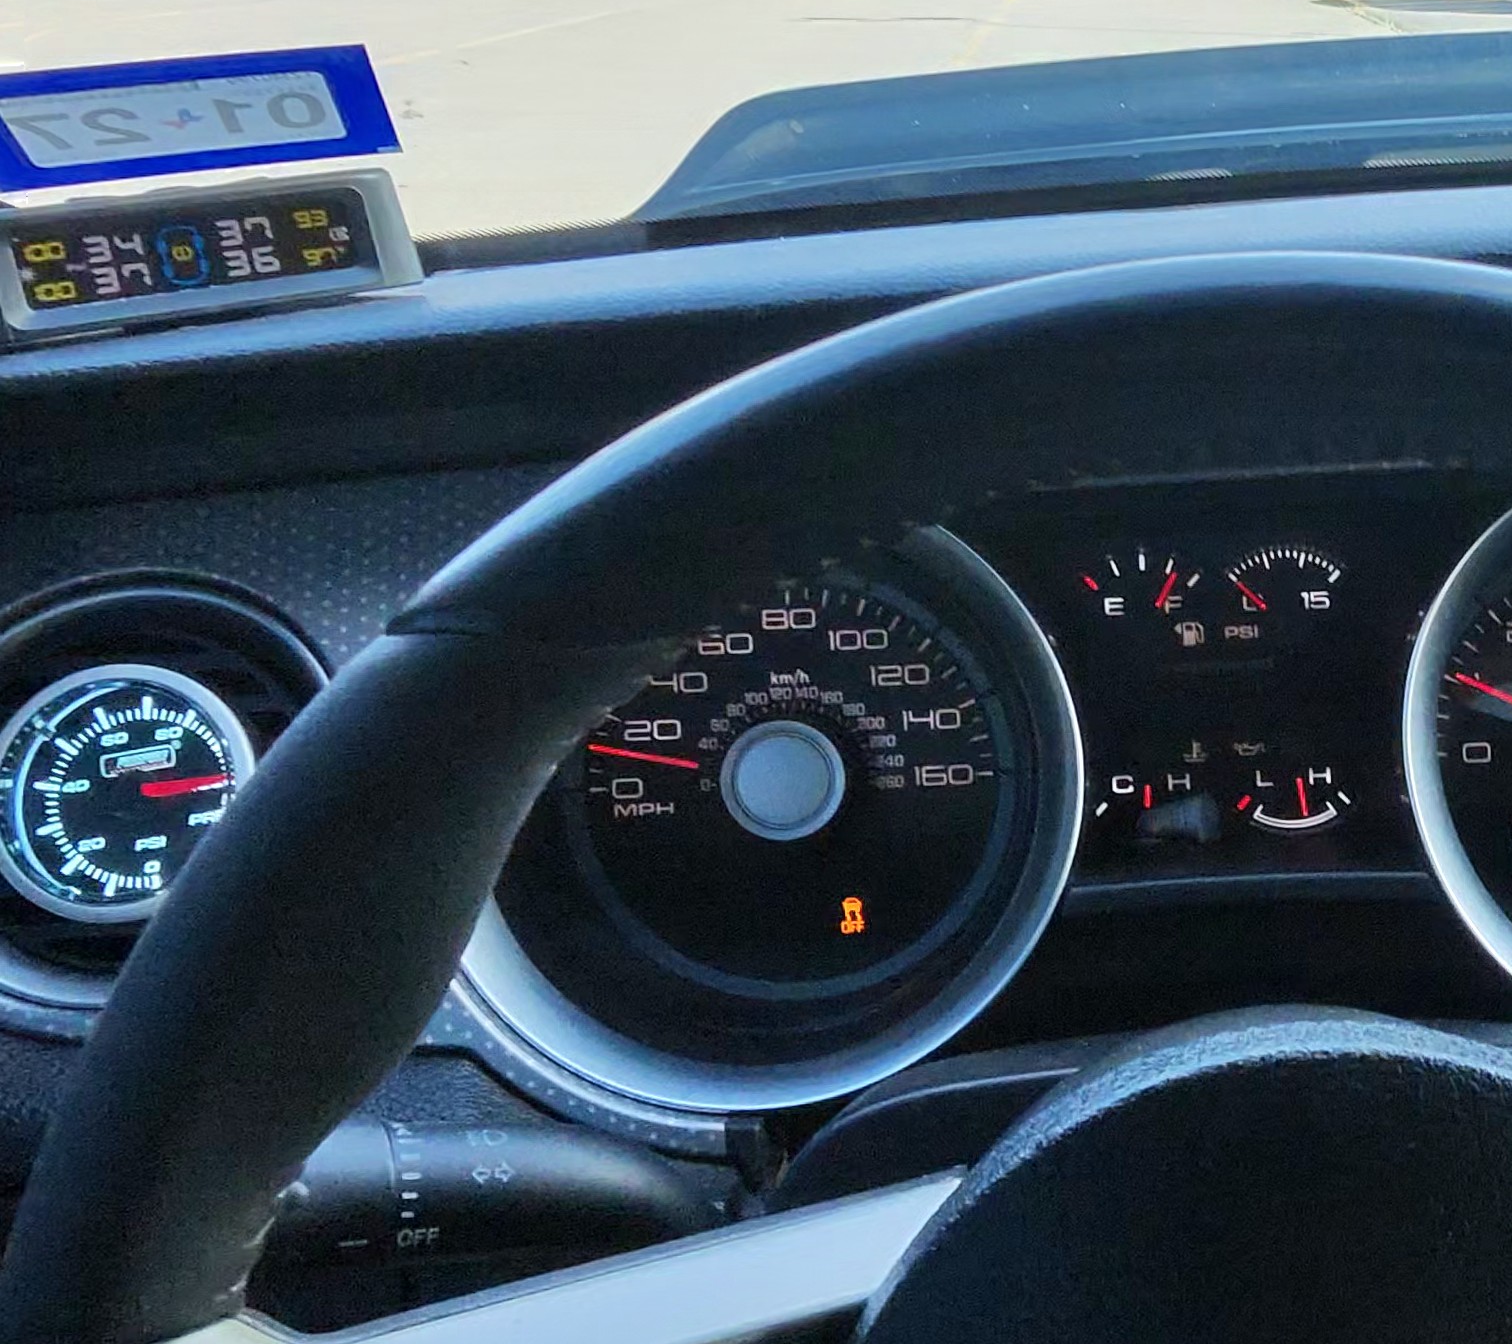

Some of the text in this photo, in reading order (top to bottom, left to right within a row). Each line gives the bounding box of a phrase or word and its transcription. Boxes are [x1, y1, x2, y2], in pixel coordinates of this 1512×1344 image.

[1104, 597, 1125, 616] E
[1300, 590, 1331, 610] 15
[761, 608, 816, 630] 80
[827, 629, 889, 651] 100
[1224, 625, 1259, 639] PSI
[698, 632, 755, 655] 60
[648, 671, 708, 693] 40
[769, 669, 811, 685] km/h
[869, 664, 930, 687] 120
[744, 692, 769, 706] 100
[902, 708, 961, 731] 140
[623, 719, 682, 742] 20
[1462, 743, 1492, 764] 0
[913, 764, 974, 787] 160
[1112, 775, 1134, 794] C
[1167, 773, 1191, 791] H
[1256, 770, 1274, 787] L
[1309, 767, 1332, 786] H
[611, 777, 643, 799] 0
[613, 802, 675, 818] MPH
[396, 1227, 440, 1248] OFF
